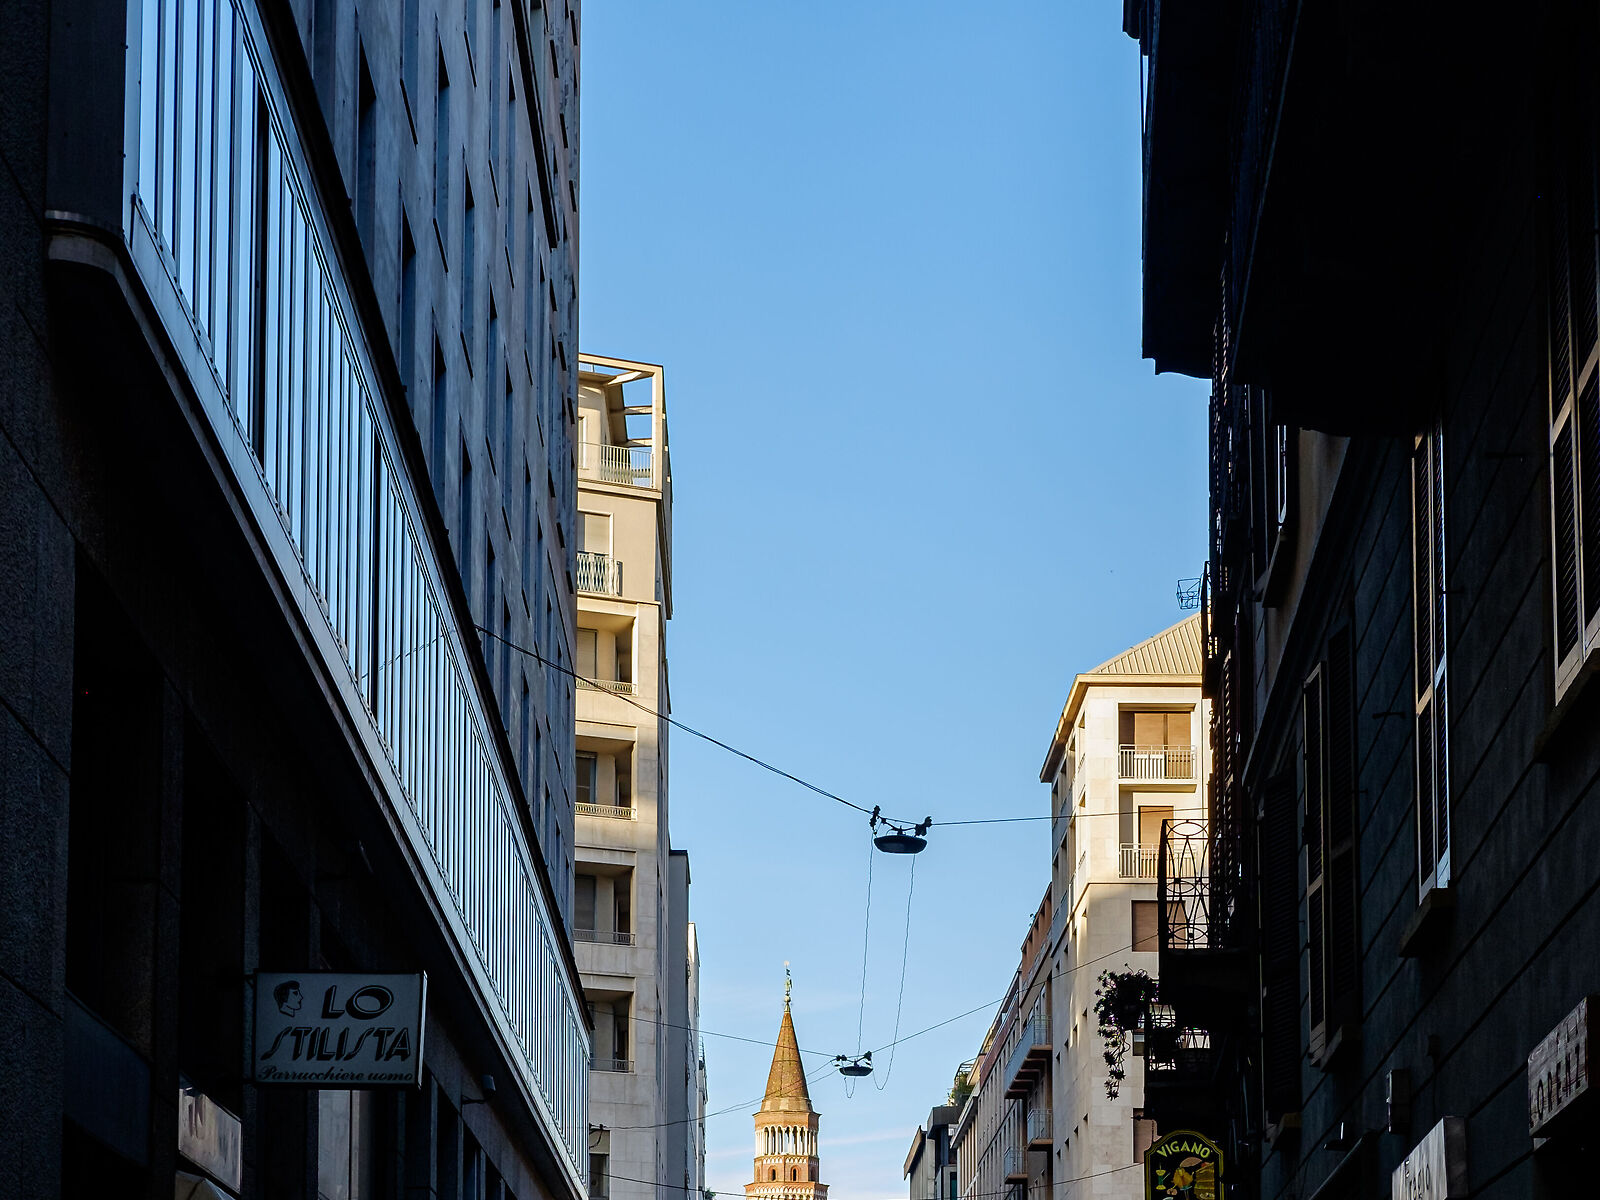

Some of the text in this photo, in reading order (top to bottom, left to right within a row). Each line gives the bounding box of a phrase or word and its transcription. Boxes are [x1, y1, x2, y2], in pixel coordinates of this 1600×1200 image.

[321, 984, 394, 1020] LO
[260, 1026, 411, 1061] STILISTA
[257, 1065, 413, 1081] Parrucchiere uomo
